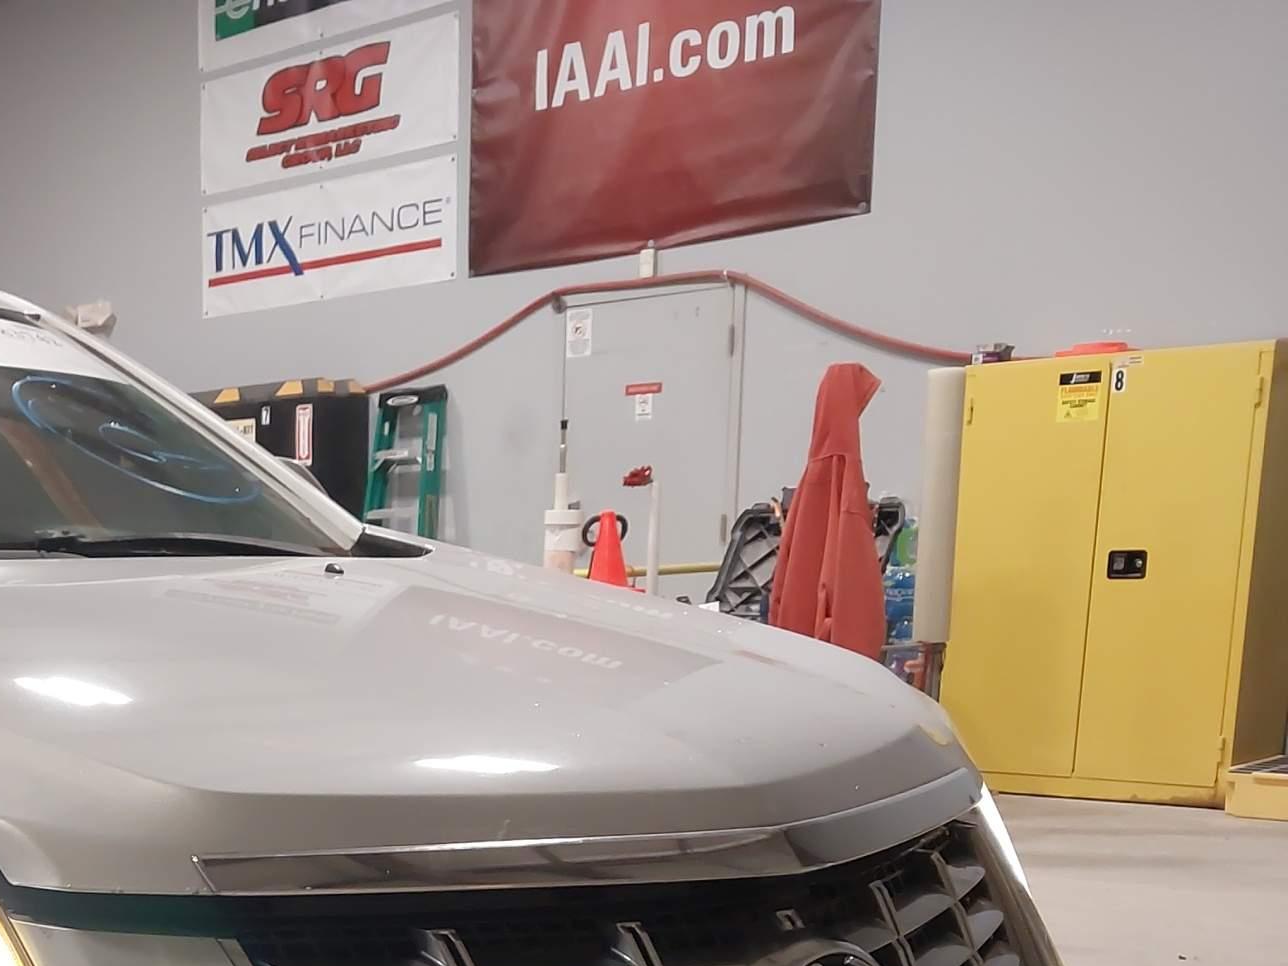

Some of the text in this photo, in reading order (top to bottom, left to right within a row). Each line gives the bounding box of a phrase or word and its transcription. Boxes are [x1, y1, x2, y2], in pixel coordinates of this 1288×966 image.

[257, 41, 391, 136] SRG
[535, 5, 795, 111] IAAI.com
[207, 215, 304, 276] TMX
[1114, 369, 1124, 391] 8
